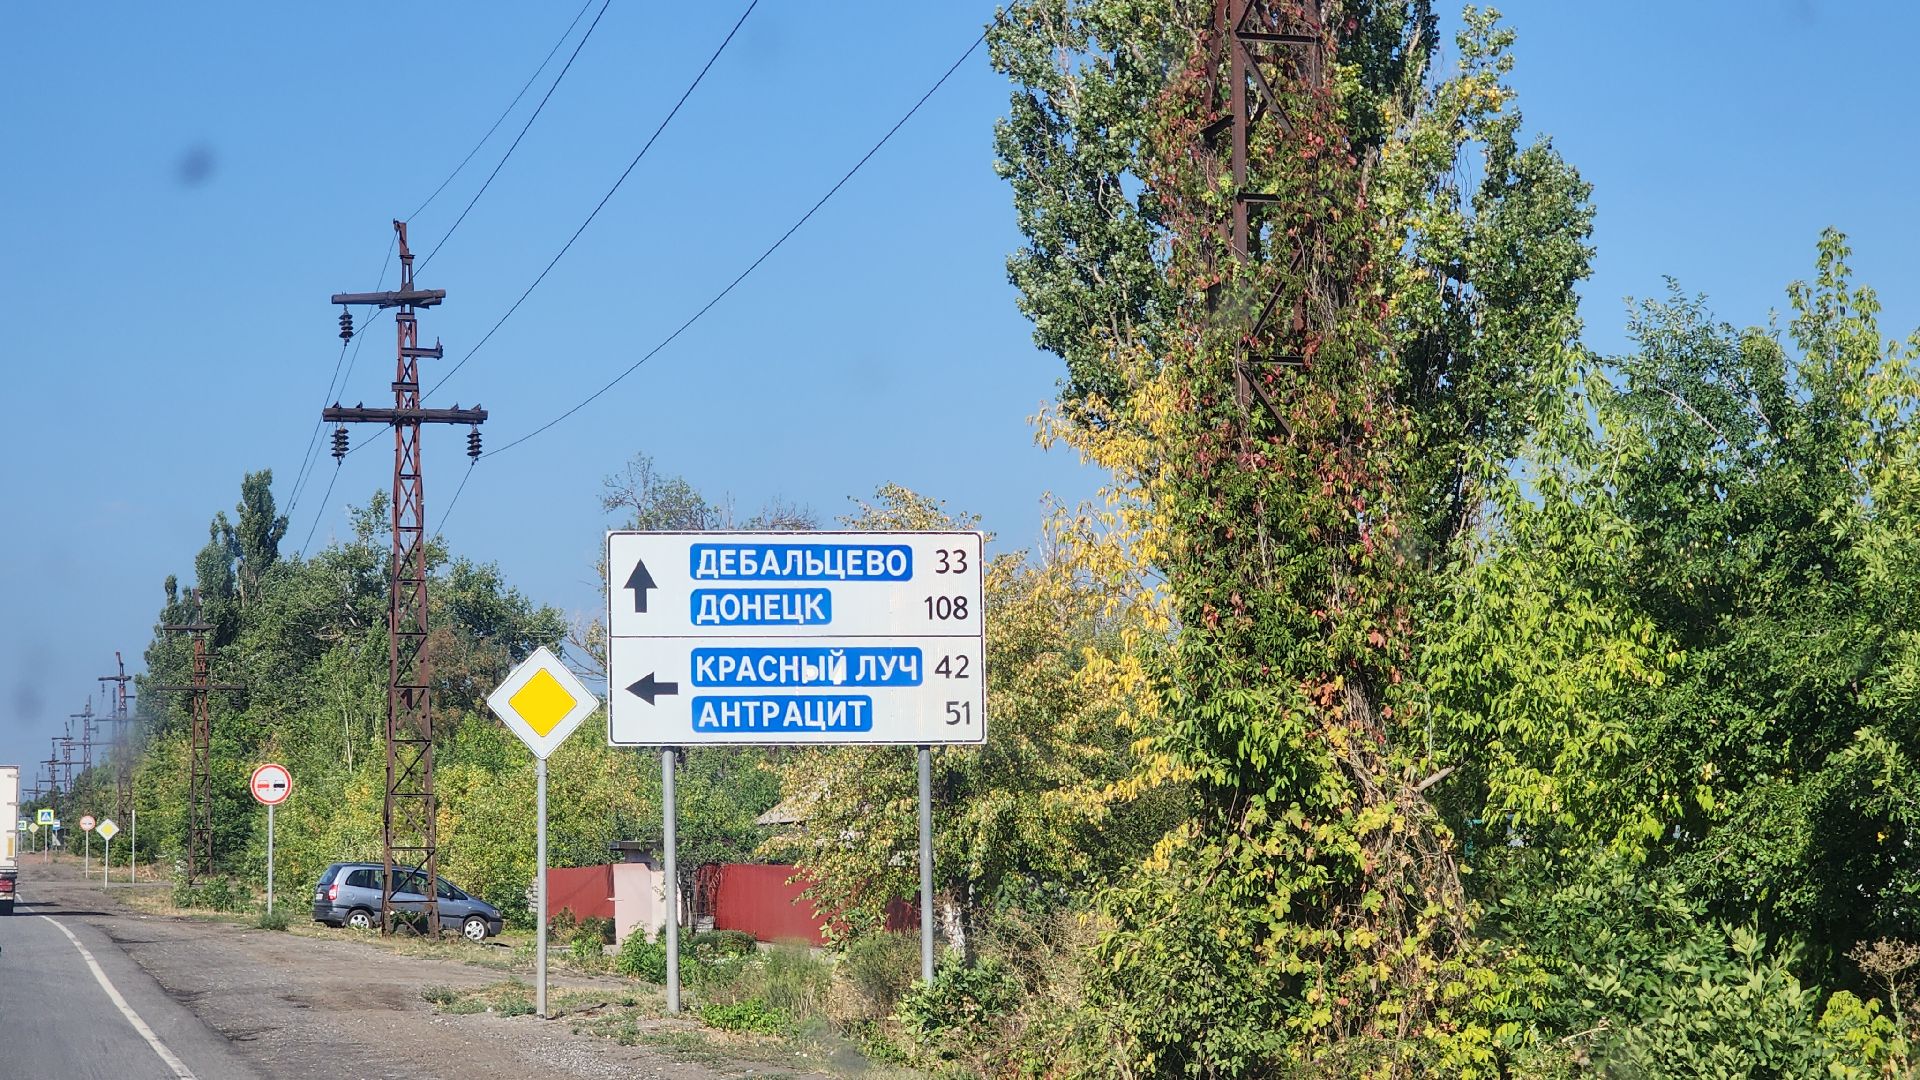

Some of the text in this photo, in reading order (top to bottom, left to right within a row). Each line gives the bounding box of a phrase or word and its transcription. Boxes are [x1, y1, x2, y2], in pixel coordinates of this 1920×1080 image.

[696, 549, 907, 579] ДЕБАЛЬЦЕВО
[934, 549, 968, 574] 33
[696, 592, 826, 624] ДОНЕЦК
[924, 595, 969, 621] 108
[696, 649, 918, 685] КРАСНЫЙ ЛУЧ
[934, 655, 970, 679] 42
[698, 700, 867, 730] АНТРАЦИТ
[945, 701, 971, 726] 51
